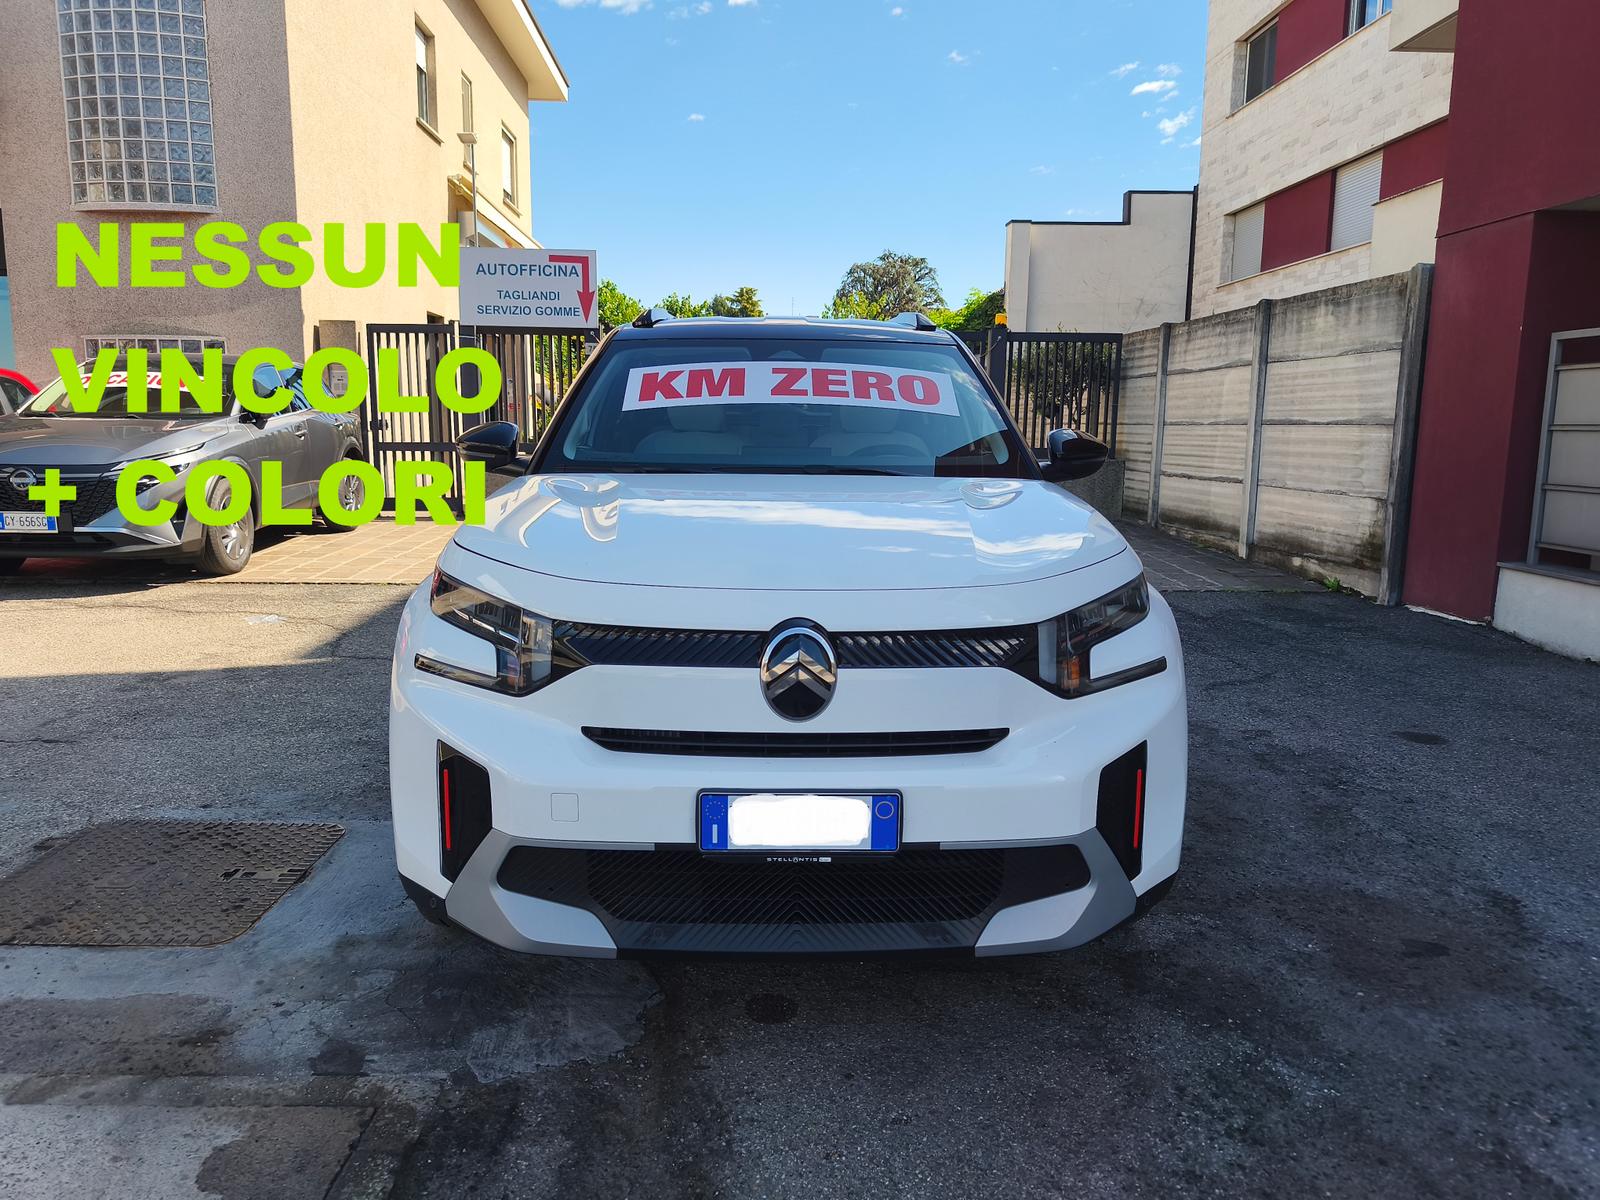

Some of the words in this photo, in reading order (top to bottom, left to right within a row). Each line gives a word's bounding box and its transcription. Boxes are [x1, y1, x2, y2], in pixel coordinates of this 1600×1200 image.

[475, 262, 580, 278] AUTOFFICINA
[496, 289, 561, 301] TAGLIANDI
[476, 304, 532, 317] SERVIZIO
[534, 306, 581, 317] GOMME
[638, 367, 746, 402] KM
[771, 367, 941, 406] ZERO
